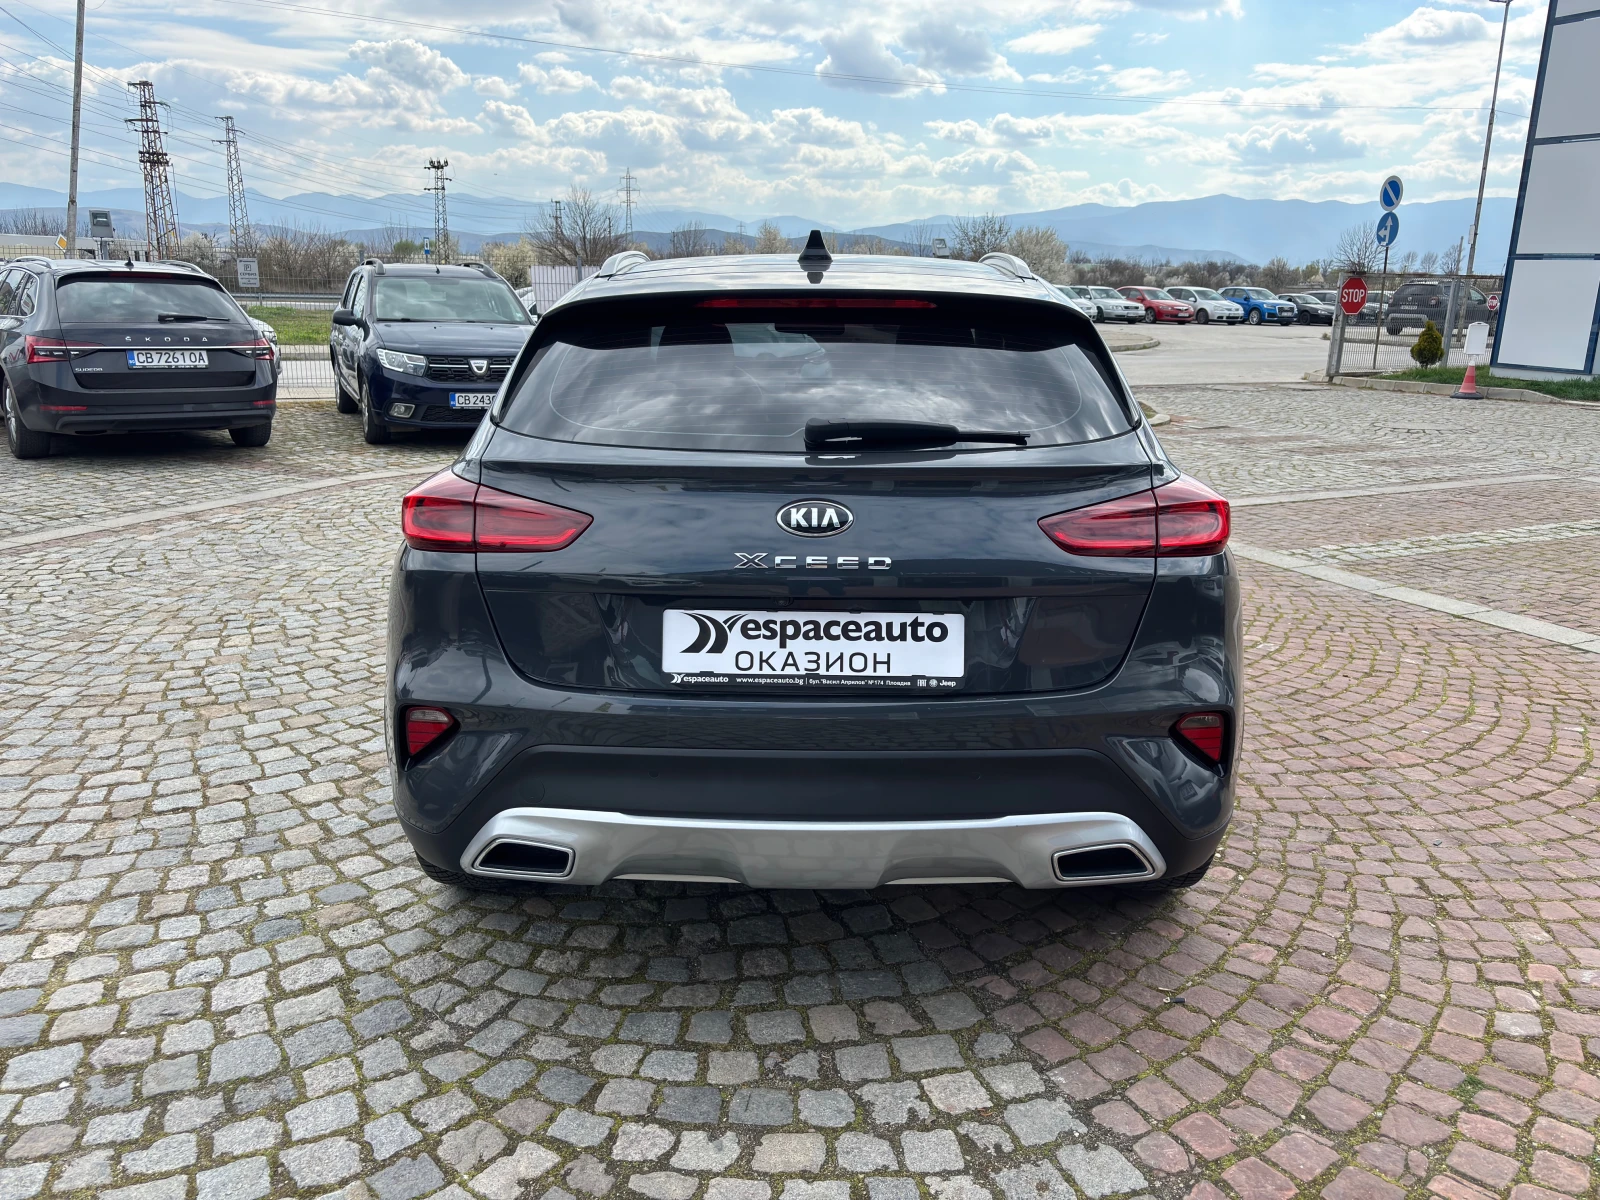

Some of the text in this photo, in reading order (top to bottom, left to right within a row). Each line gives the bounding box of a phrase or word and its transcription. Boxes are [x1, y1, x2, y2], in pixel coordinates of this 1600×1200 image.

[1341, 289, 1365, 303] STOP
[790, 508, 841, 527] KIA
[734, 553, 892, 570] XCEED
[740, 616, 949, 649] espaceauto
[735, 651, 891, 673] ОКАЗИОН
[683, 675, 729, 685] espaceauto
[735, 676, 804, 686] www.espaceauto.bg
[940, 679, 957, 688] Jeep
